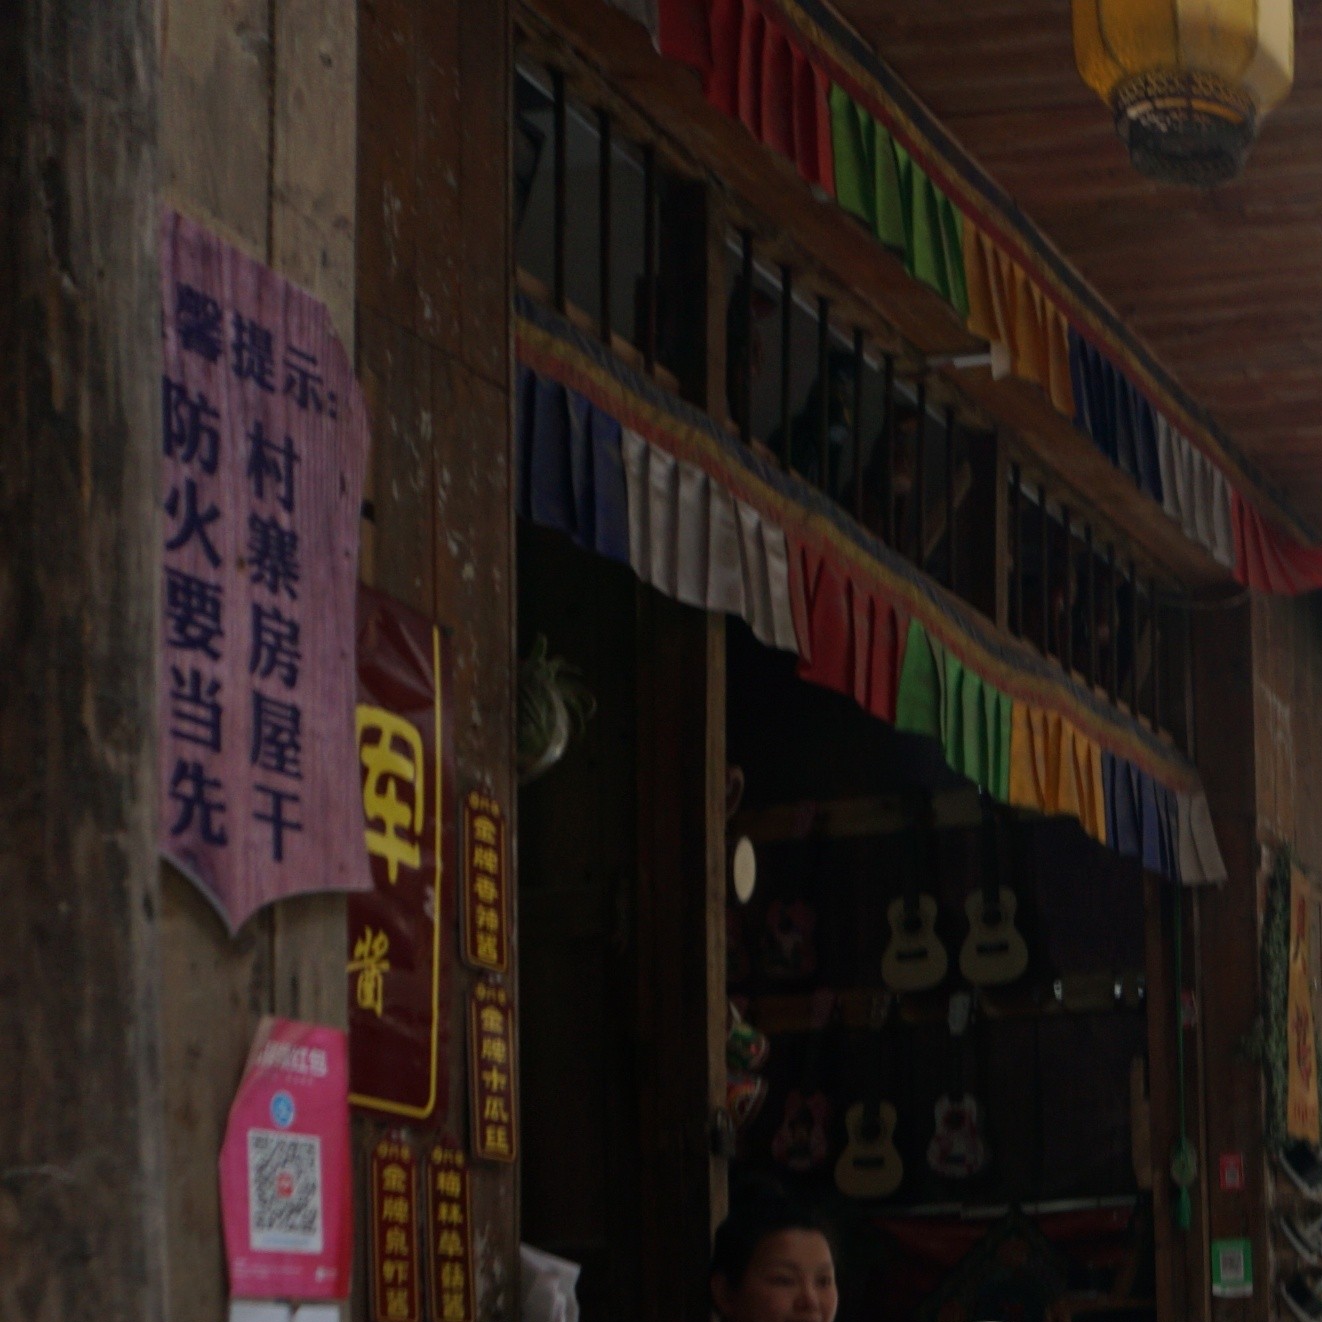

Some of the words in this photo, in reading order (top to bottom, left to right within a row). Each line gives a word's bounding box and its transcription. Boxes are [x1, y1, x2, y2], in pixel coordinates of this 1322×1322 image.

[161, 377, 229, 848] 防火要当先
